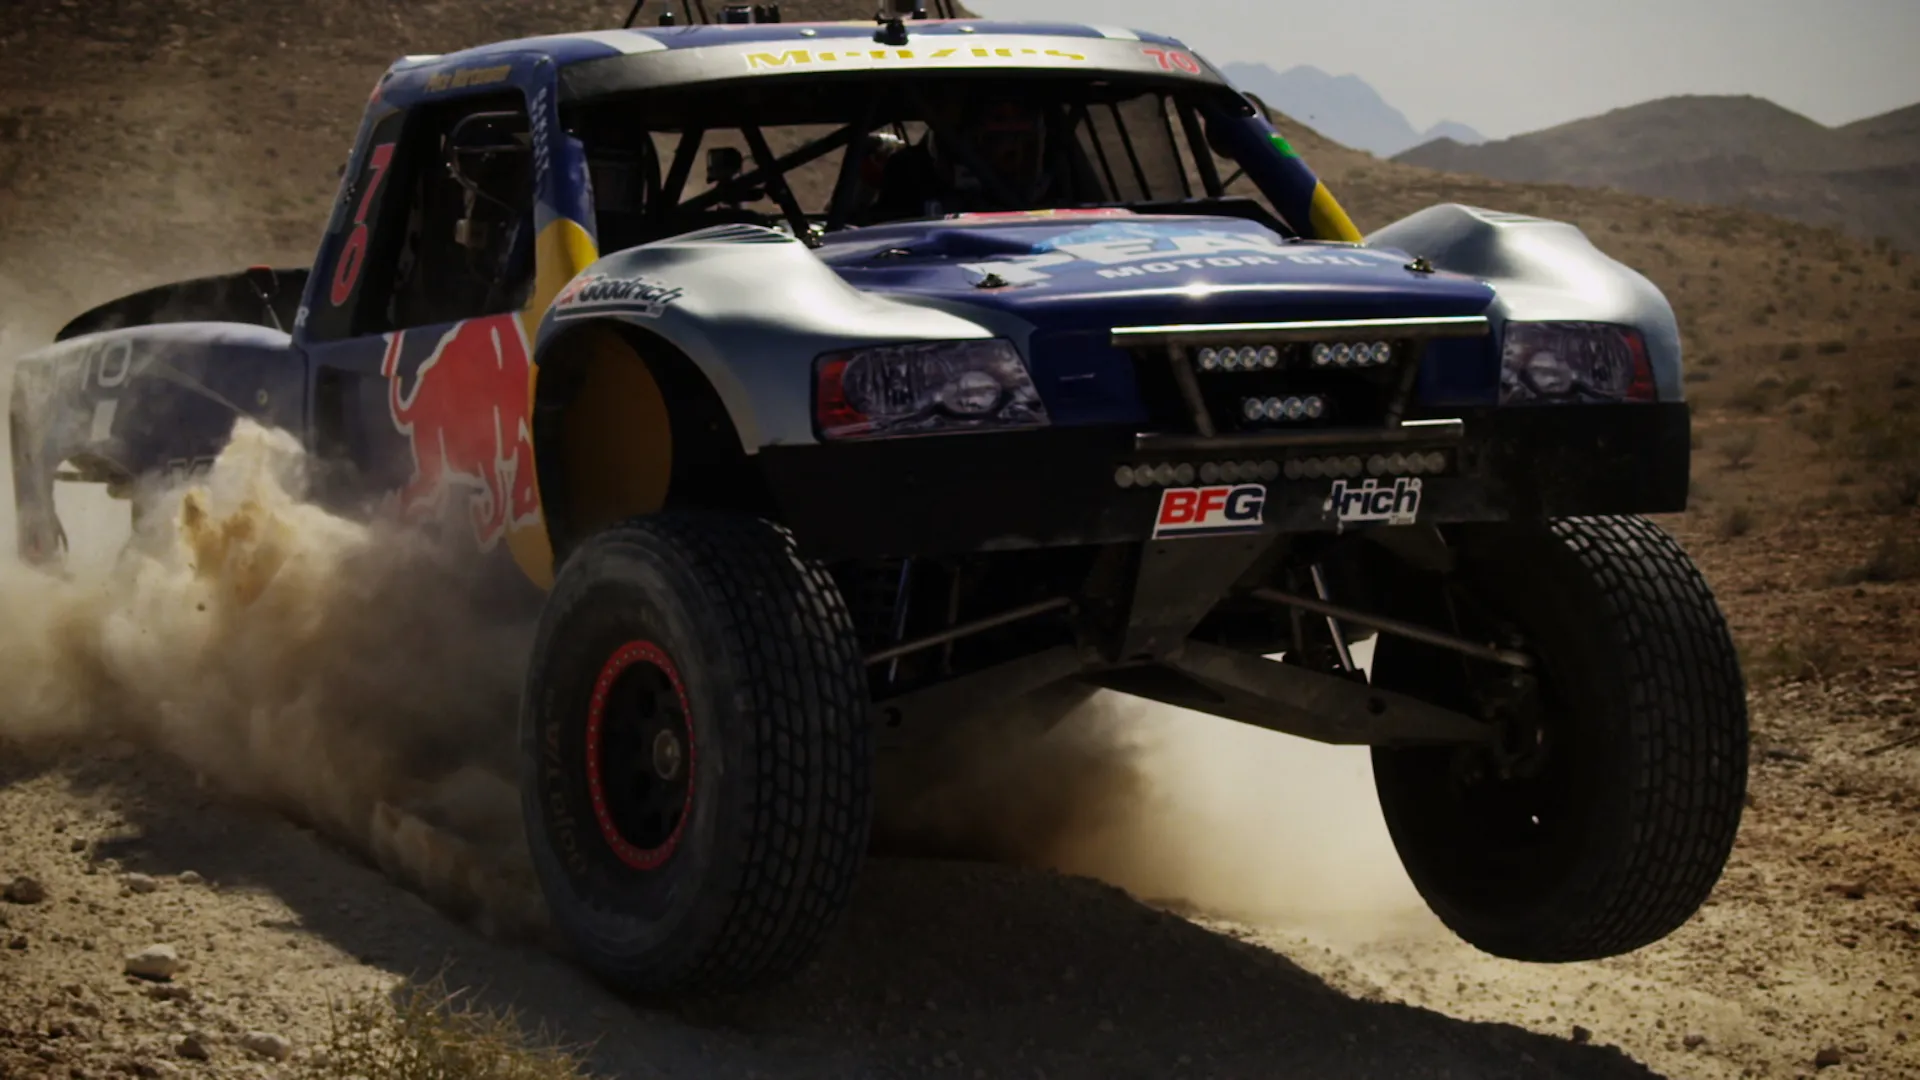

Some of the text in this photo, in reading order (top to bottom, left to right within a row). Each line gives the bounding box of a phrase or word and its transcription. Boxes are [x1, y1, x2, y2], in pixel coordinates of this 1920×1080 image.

[1141, 47, 1201, 74] 70
[329, 142, 396, 307] 70
[1095, 253, 1378, 280] MOTOR OIL
[1159, 487, 1264, 523] BFG
